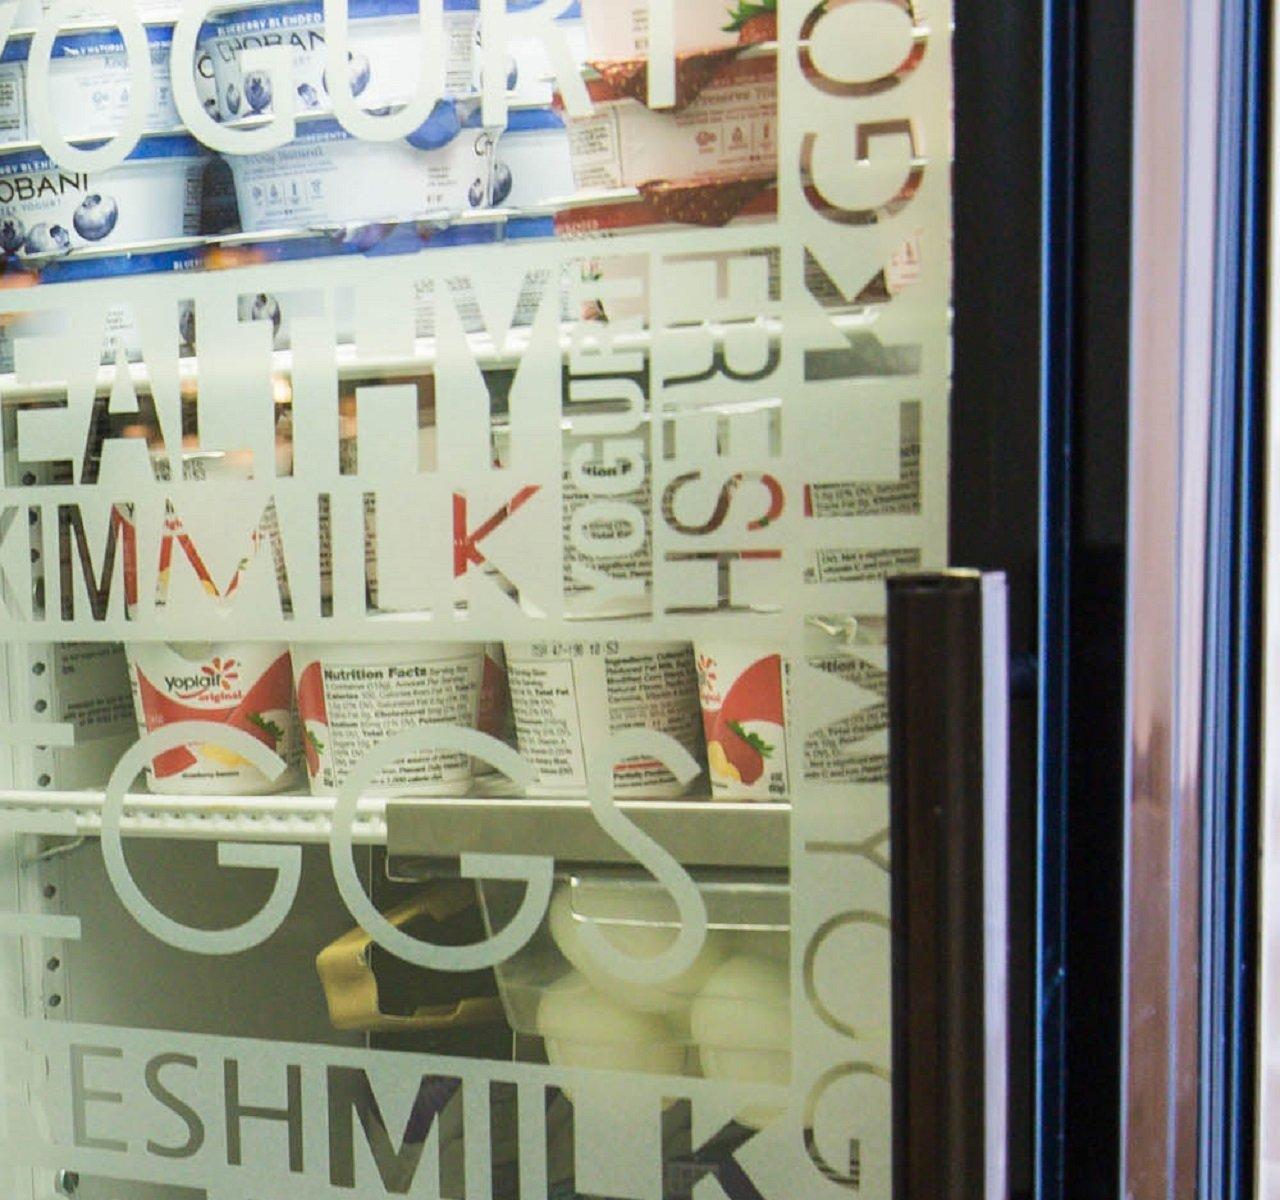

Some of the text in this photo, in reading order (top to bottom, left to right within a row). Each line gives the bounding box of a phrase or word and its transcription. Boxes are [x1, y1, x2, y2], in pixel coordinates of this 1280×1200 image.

[661, 244, 786, 616] FRESH
[324, 666, 427, 681] Nutrition Facts
